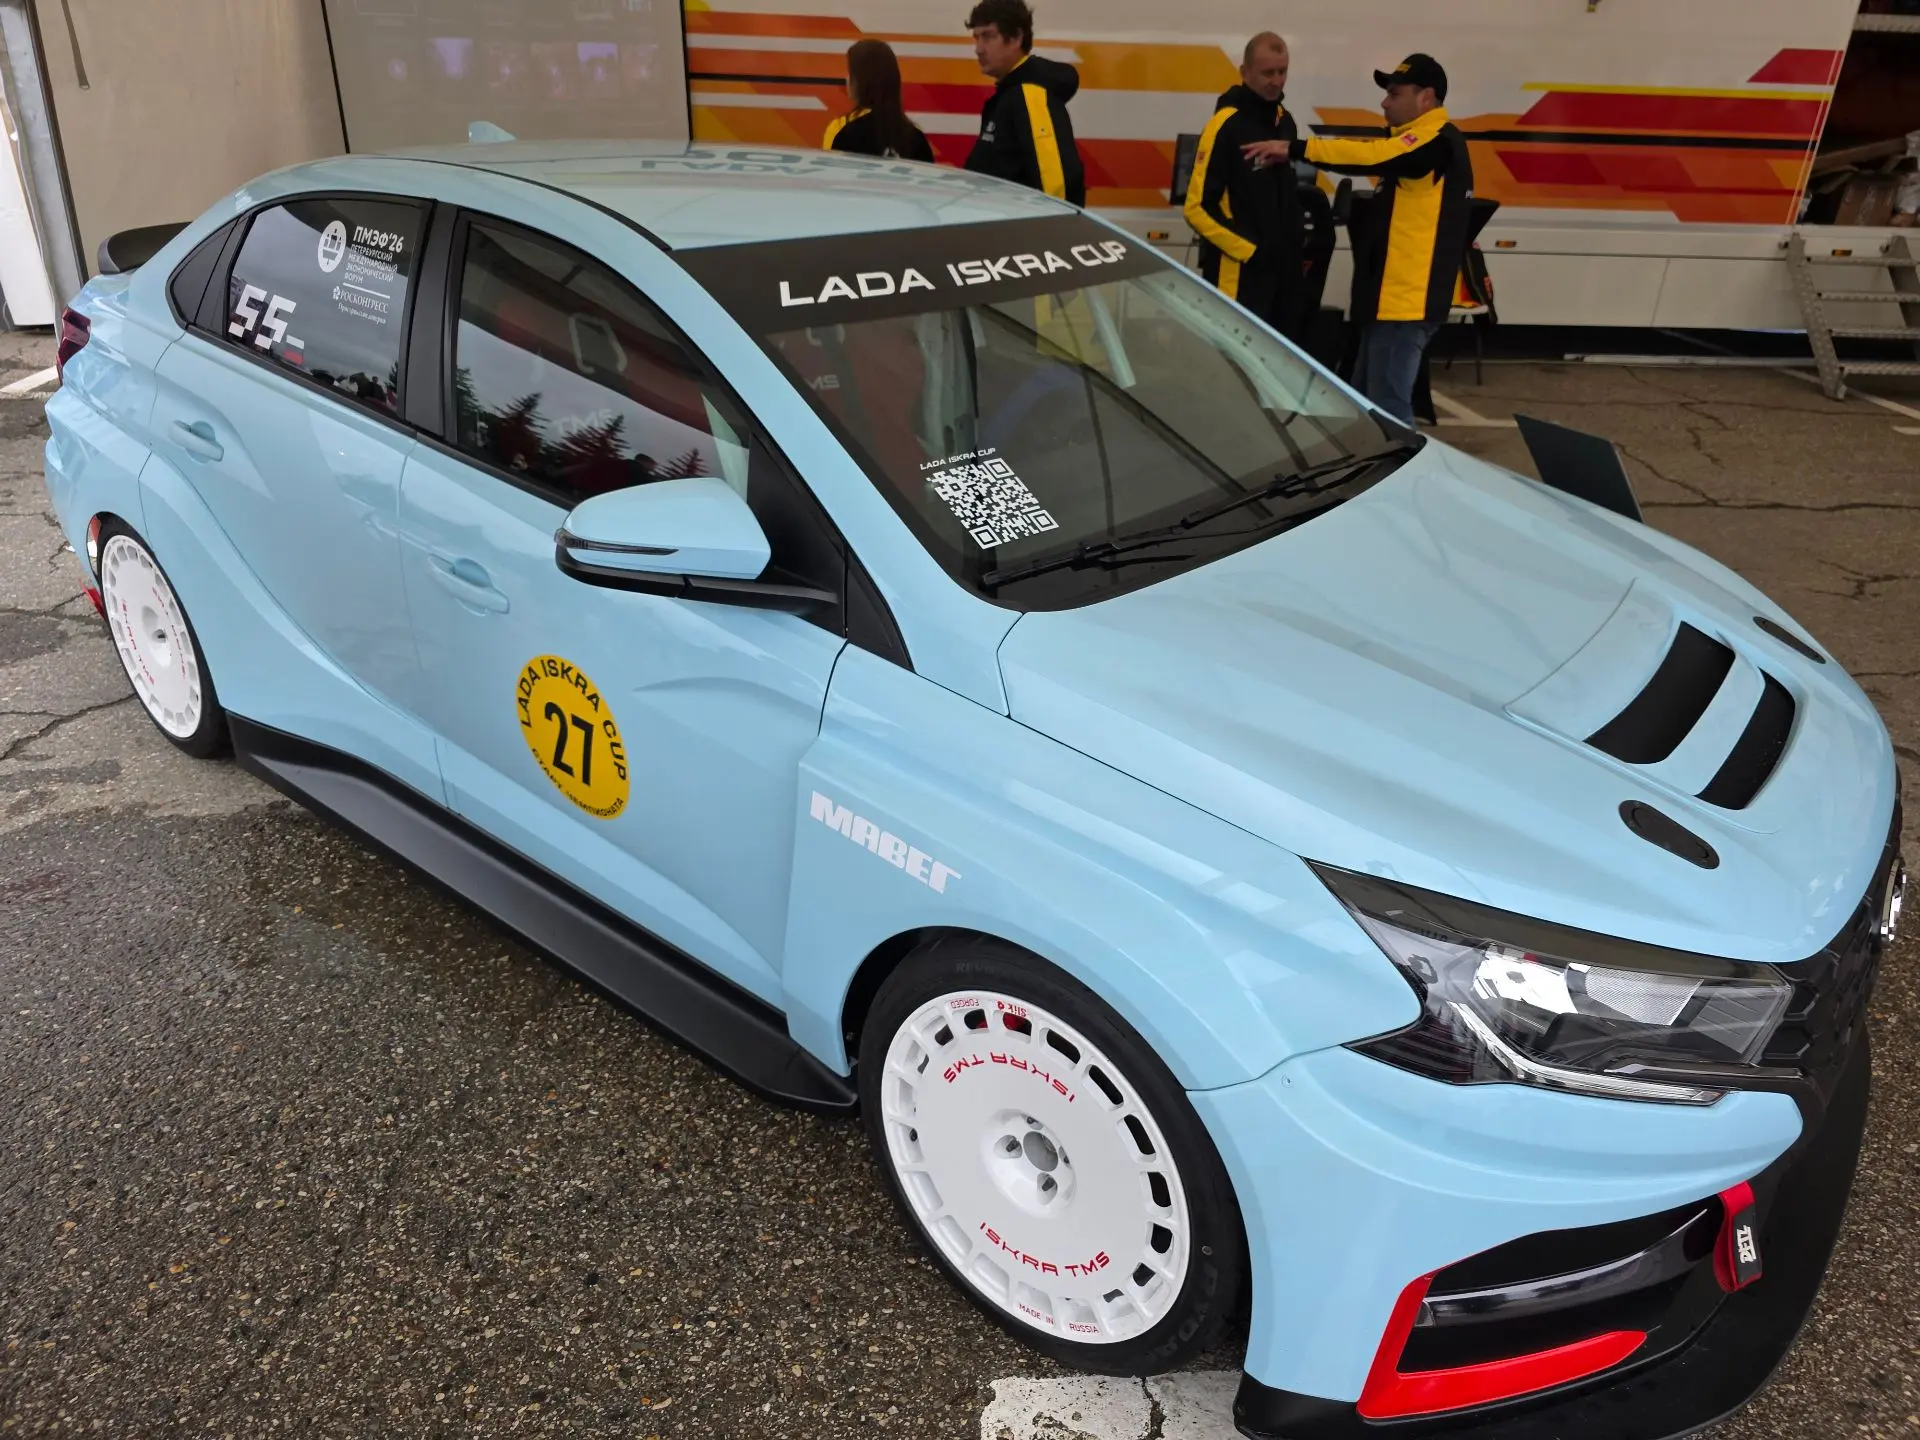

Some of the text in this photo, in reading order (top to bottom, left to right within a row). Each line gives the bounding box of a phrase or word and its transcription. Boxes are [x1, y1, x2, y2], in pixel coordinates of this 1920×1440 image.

[779, 240, 1127, 307] LADA ISKRA CUP
[920, 447, 996, 470] LADA ISKRA CUP
[518, 659, 627, 781] LADA ISKRA CUP
[544, 702, 594, 787] 27
[951, 998, 980, 1009] FORGED
[943, 1052, 1075, 1103] ISKRA TMS
[980, 1222, 1110, 1277] ISKRA TMS
[1019, 1303, 1099, 1333] MADE IN RUSSIA
